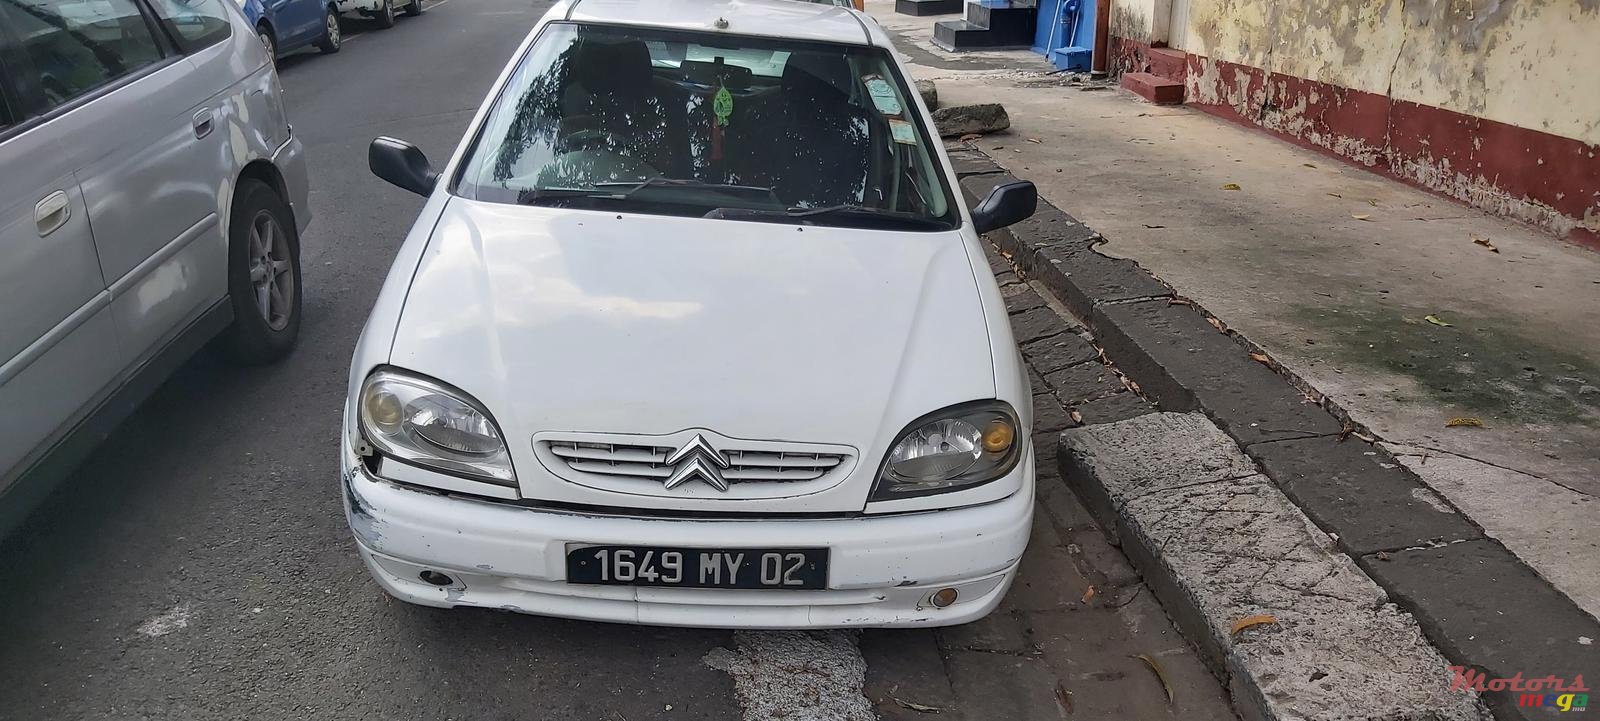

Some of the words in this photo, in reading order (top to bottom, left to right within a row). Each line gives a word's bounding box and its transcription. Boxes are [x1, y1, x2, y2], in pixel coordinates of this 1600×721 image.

[594, 549, 683, 583] 1649
[699, 552, 745, 585] MY
[760, 552, 806, 586] 02
